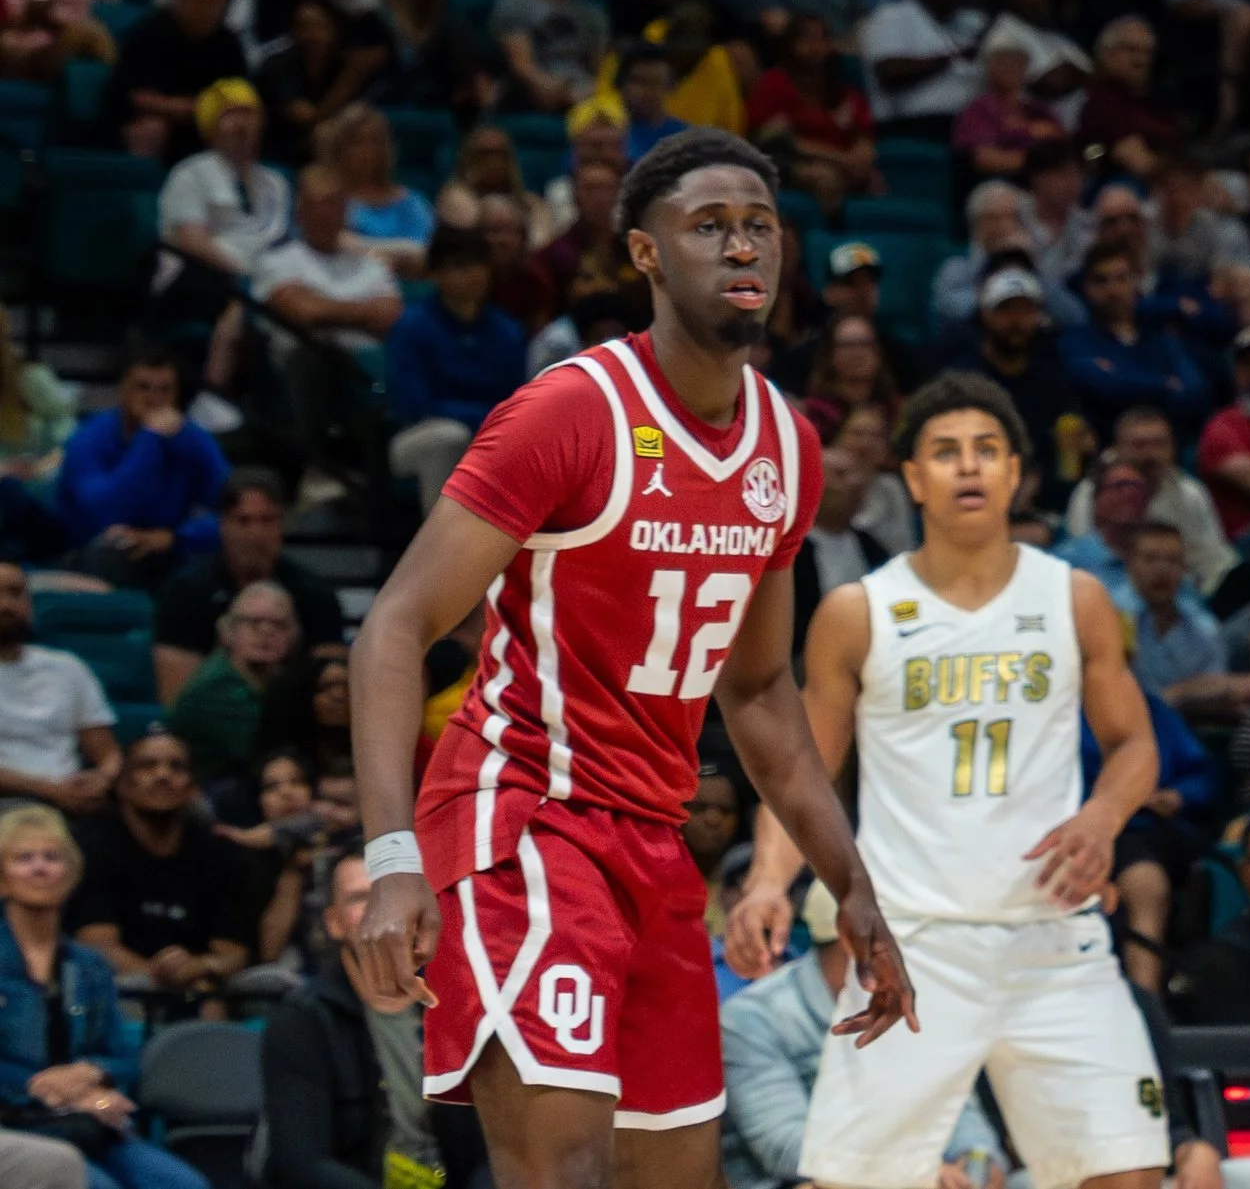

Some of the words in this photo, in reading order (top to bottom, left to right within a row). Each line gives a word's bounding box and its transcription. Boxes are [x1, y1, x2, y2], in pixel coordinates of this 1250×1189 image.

[630, 519, 776, 557] OKLAHOMA
[626, 569, 753, 701] 12
[903, 650, 1052, 711] BUFFS
[951, 718, 1014, 796] 11
[539, 964, 605, 1055] OU
